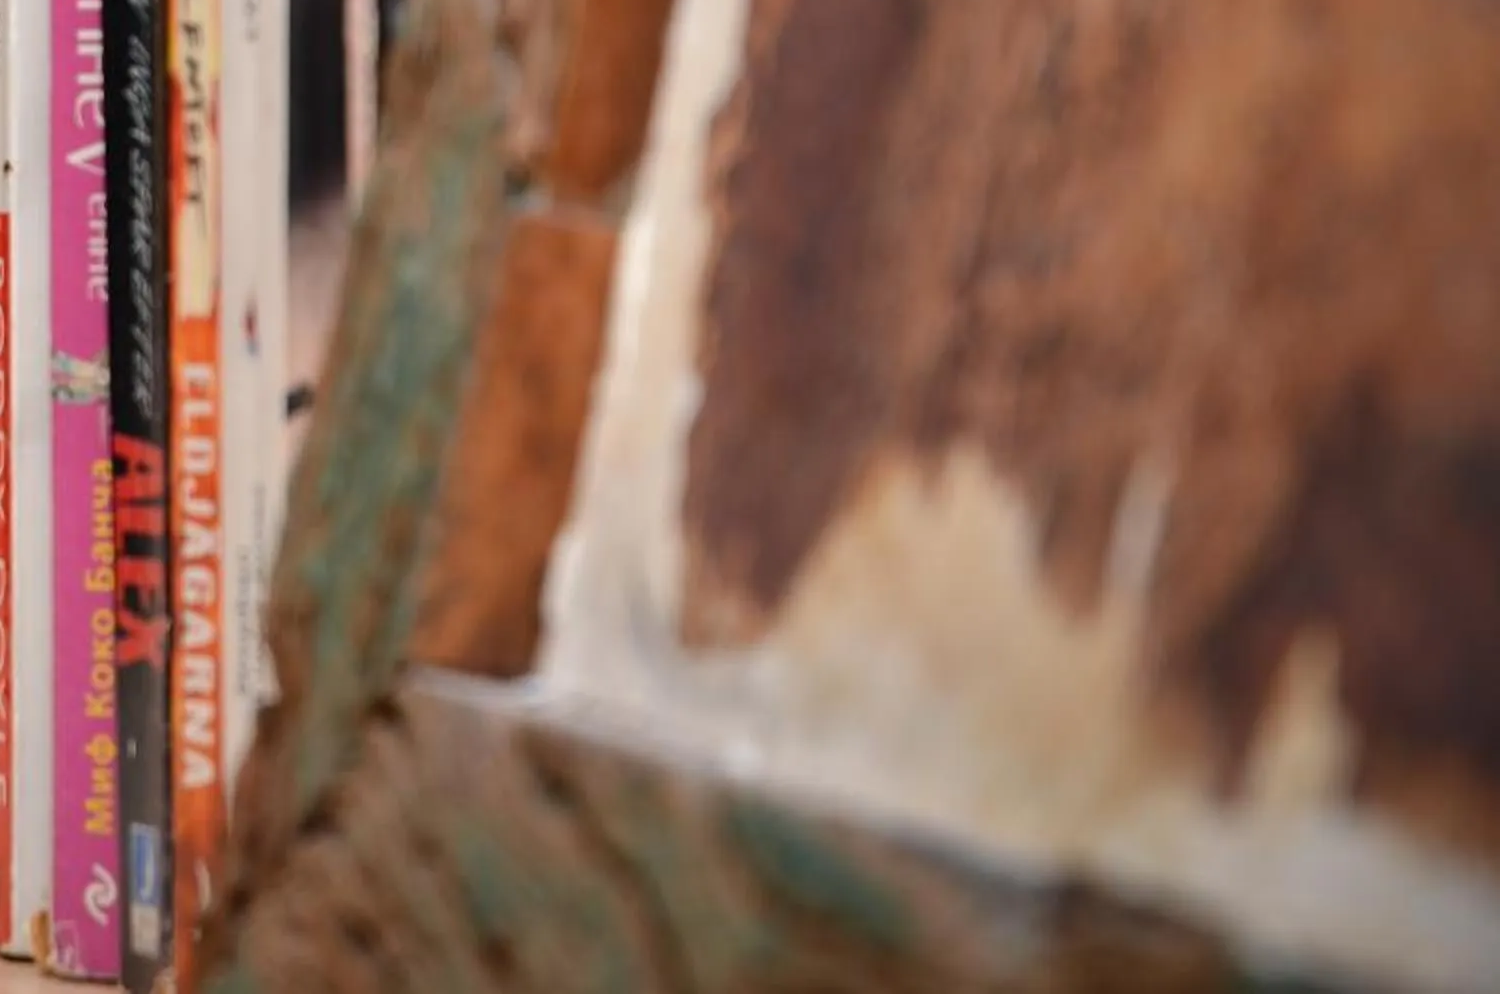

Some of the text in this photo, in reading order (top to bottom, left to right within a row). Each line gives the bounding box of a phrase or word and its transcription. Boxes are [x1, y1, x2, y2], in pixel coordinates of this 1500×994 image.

[130, 269, 154, 418] EFTER
[83, 459, 118, 834] Миф Коко Банча
[114, 433, 164, 668] ALEX
